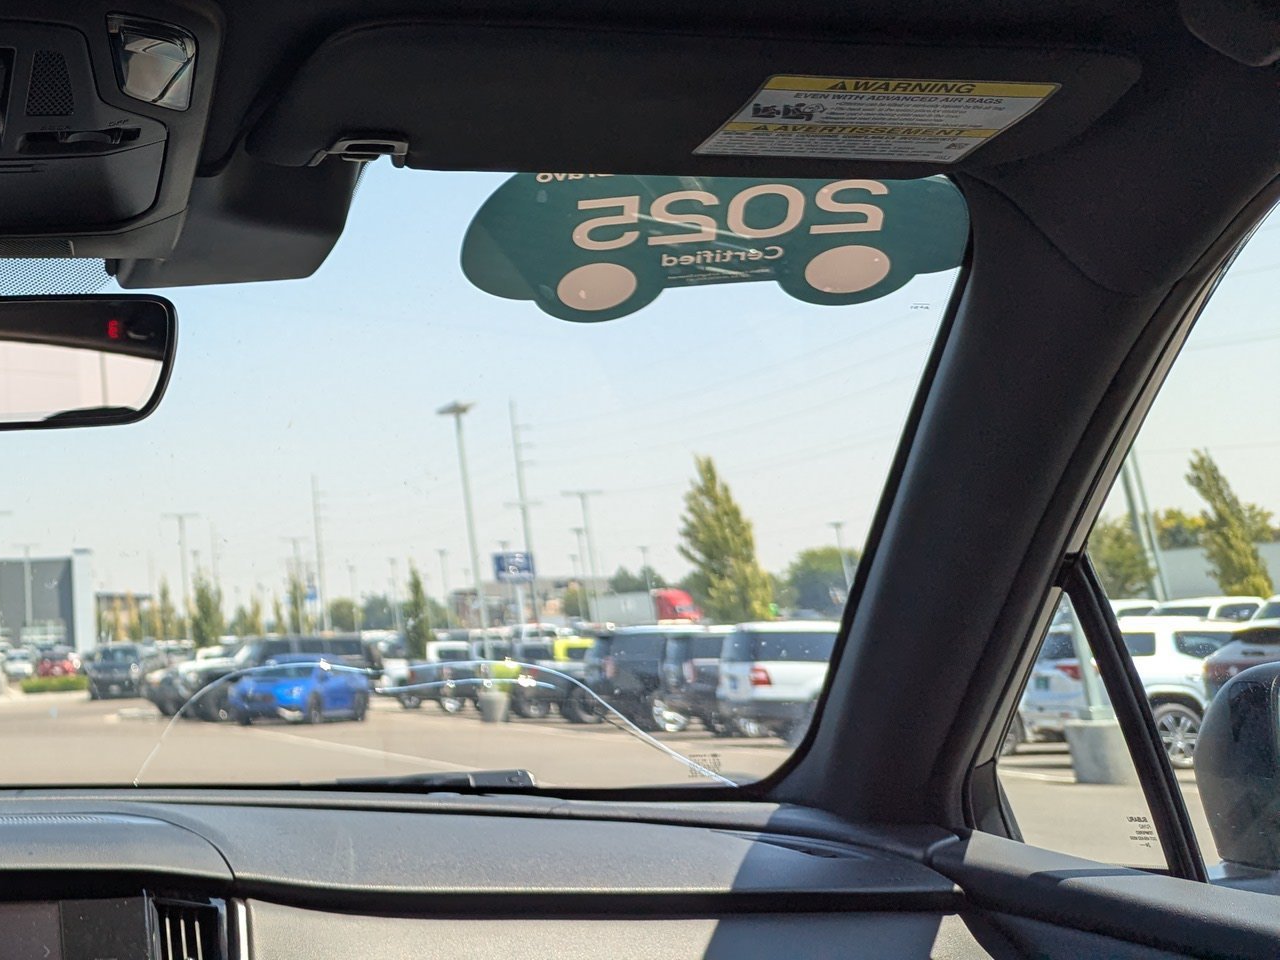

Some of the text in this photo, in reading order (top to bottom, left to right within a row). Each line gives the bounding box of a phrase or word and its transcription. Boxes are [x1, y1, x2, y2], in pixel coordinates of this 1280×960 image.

[852, 80, 977, 94] WARNING
[793, 92, 830, 100] EVEN
[866, 94, 938, 102] ADVANCED
[776, 125, 967, 136] AVERTISSEMENT
